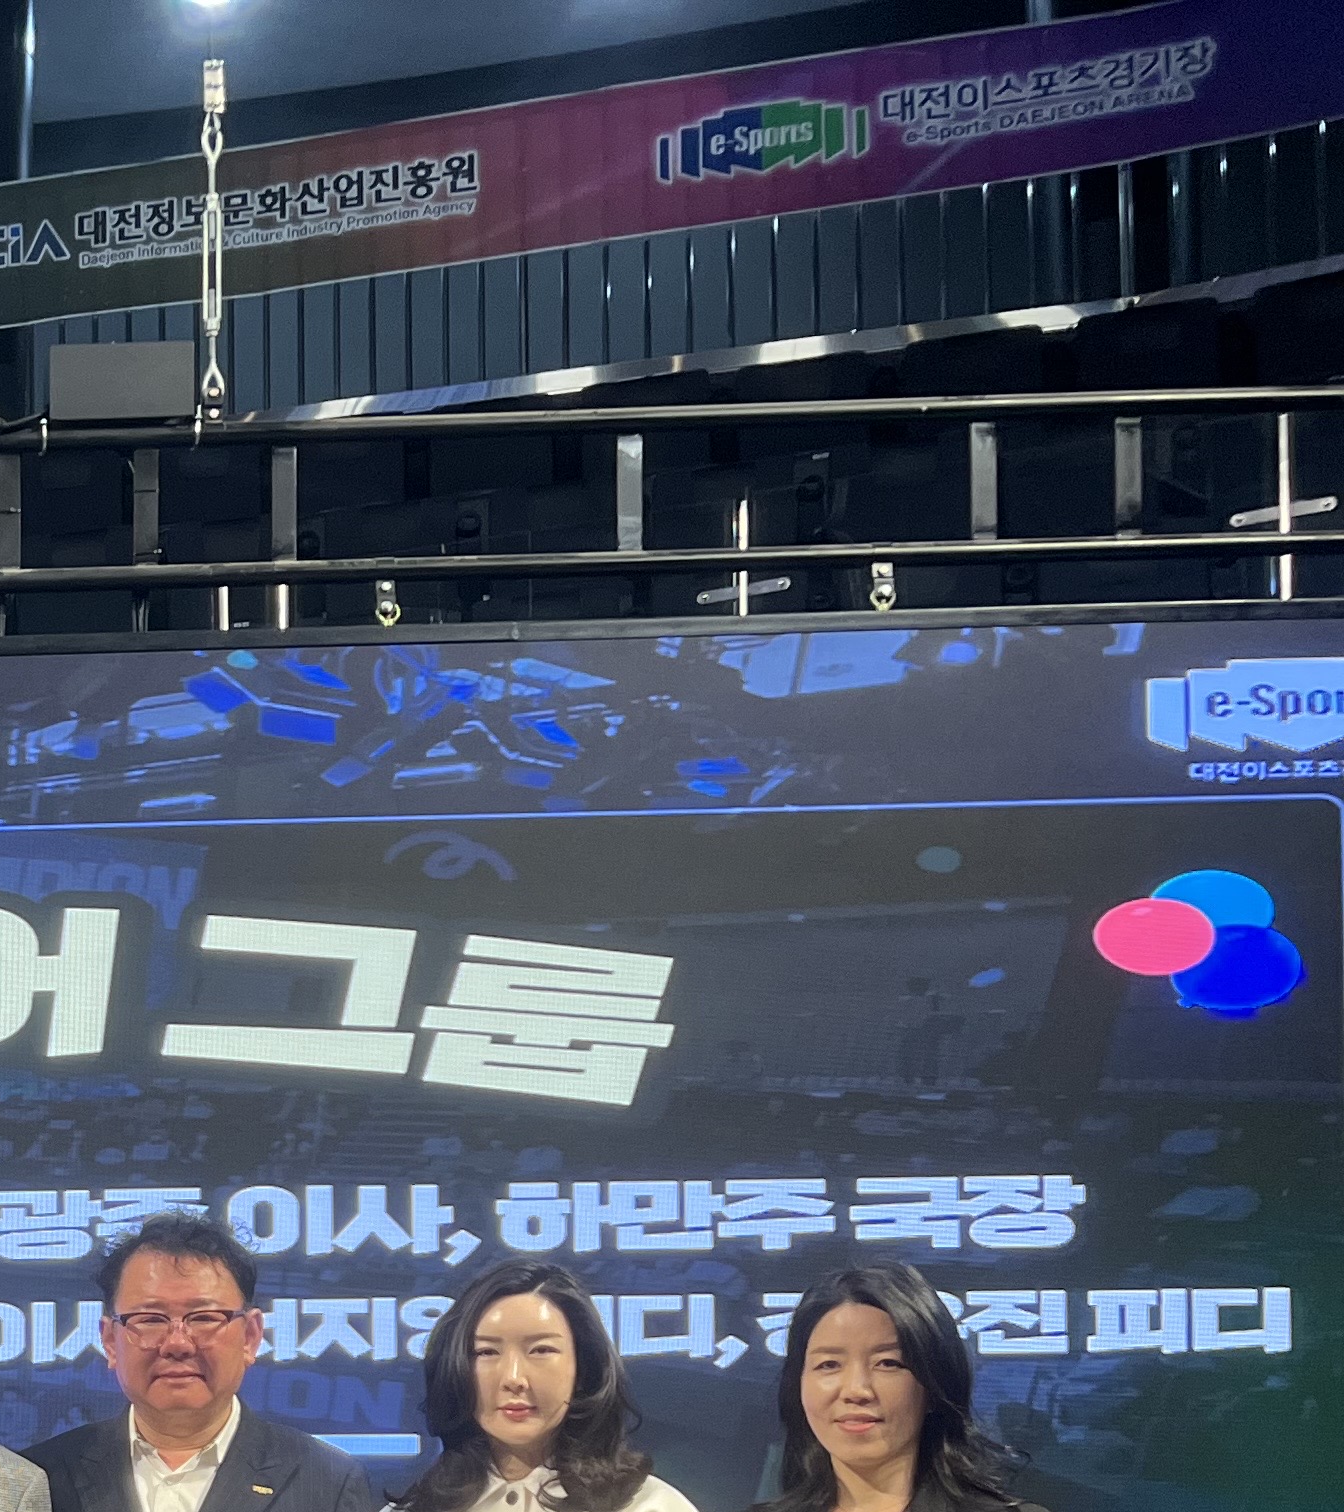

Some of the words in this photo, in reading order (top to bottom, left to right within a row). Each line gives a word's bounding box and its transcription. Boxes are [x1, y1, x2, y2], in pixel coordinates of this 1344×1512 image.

[881, 39, 1212, 122] 대전이스포츠경기장
[710, 121, 814, 156] e-Sports
[905, 121, 992, 144] e-Sports
[80, 250, 135, 268] Daejeon
[231, 230, 284, 247] Culture
[286, 218, 344, 239] Industry
[346, 208, 419, 230] Promotion
[422, 200, 476, 217] Agency
[1189, 759, 1344, 785] 대전이스포츠
[161, 913, 675, 1107] 그룹
[227, 1183, 483, 1266] 이사,
[495, 1179, 836, 1253] 하만주
[848, 1174, 1087, 1250] 국장
[1086, 1286, 1292, 1355] 피디
